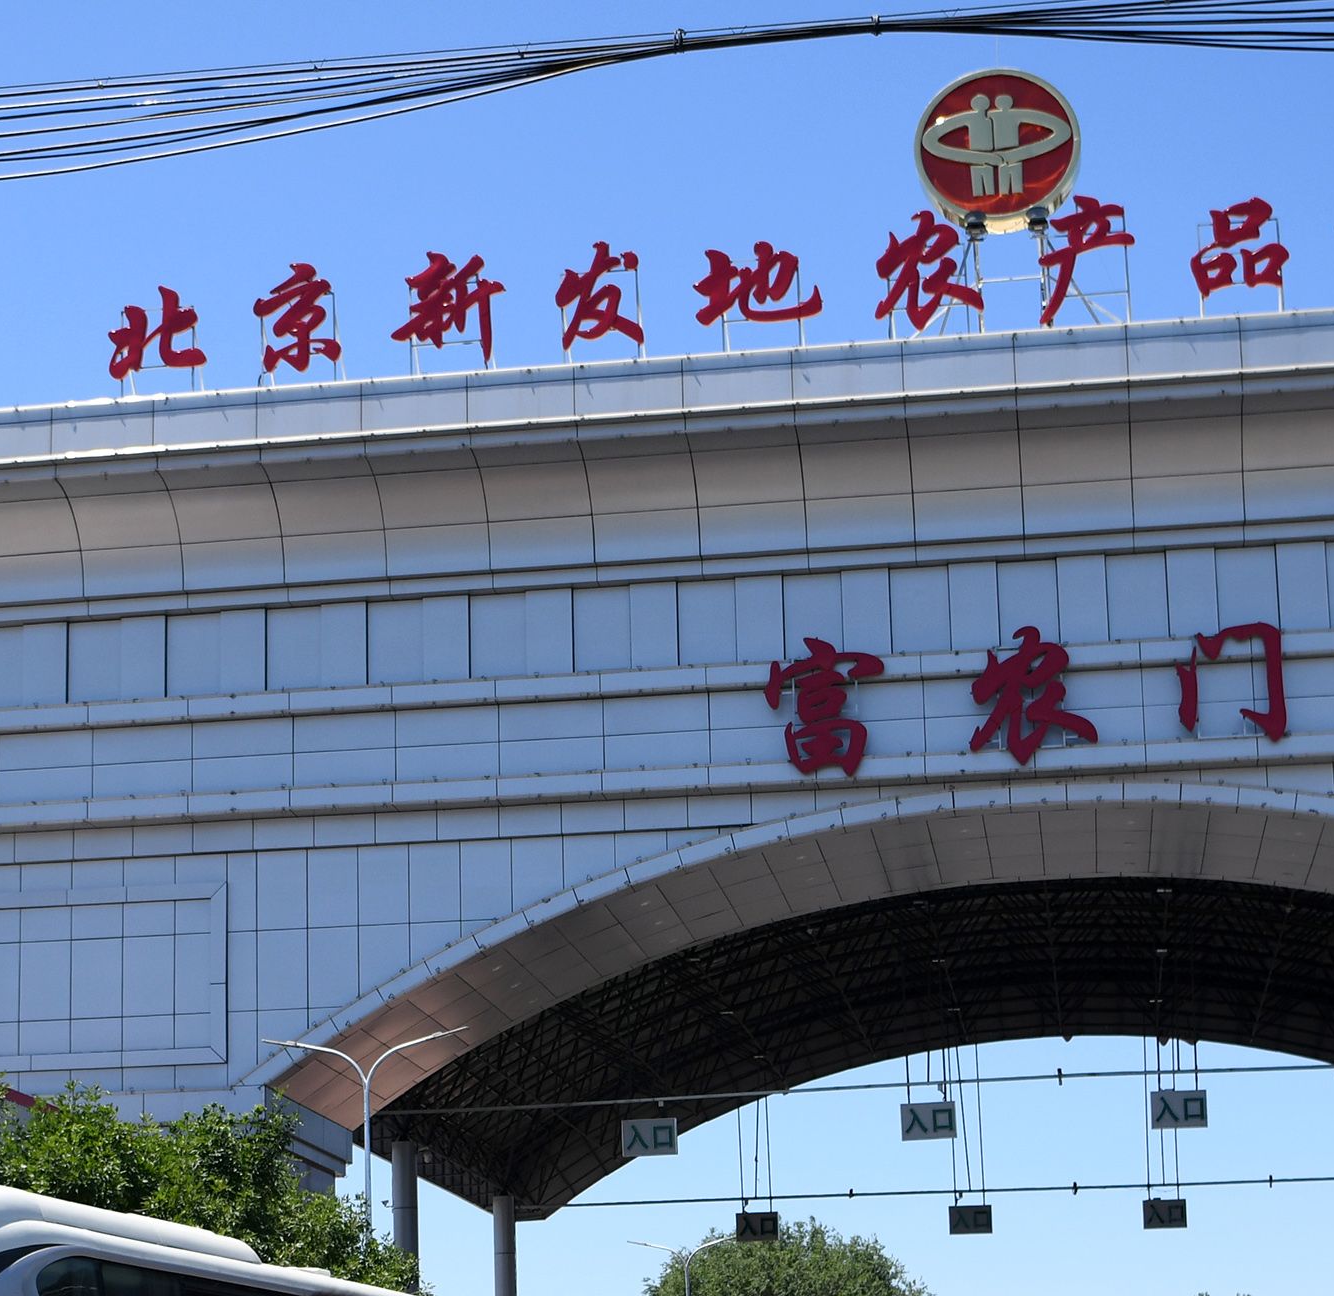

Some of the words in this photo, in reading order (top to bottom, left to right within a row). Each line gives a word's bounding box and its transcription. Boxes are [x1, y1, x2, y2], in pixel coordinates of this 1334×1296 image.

[764, 624, 1287, 775] 富农门
[905, 1108, 954, 1134] 入口
[1155, 1096, 1205, 1122] 入口
[626, 1124, 675, 1150] 入口
[738, 1217, 779, 1237] 入口
[952, 1210, 990, 1230] 入口
[1147, 1204, 1185, 1225] 入口
